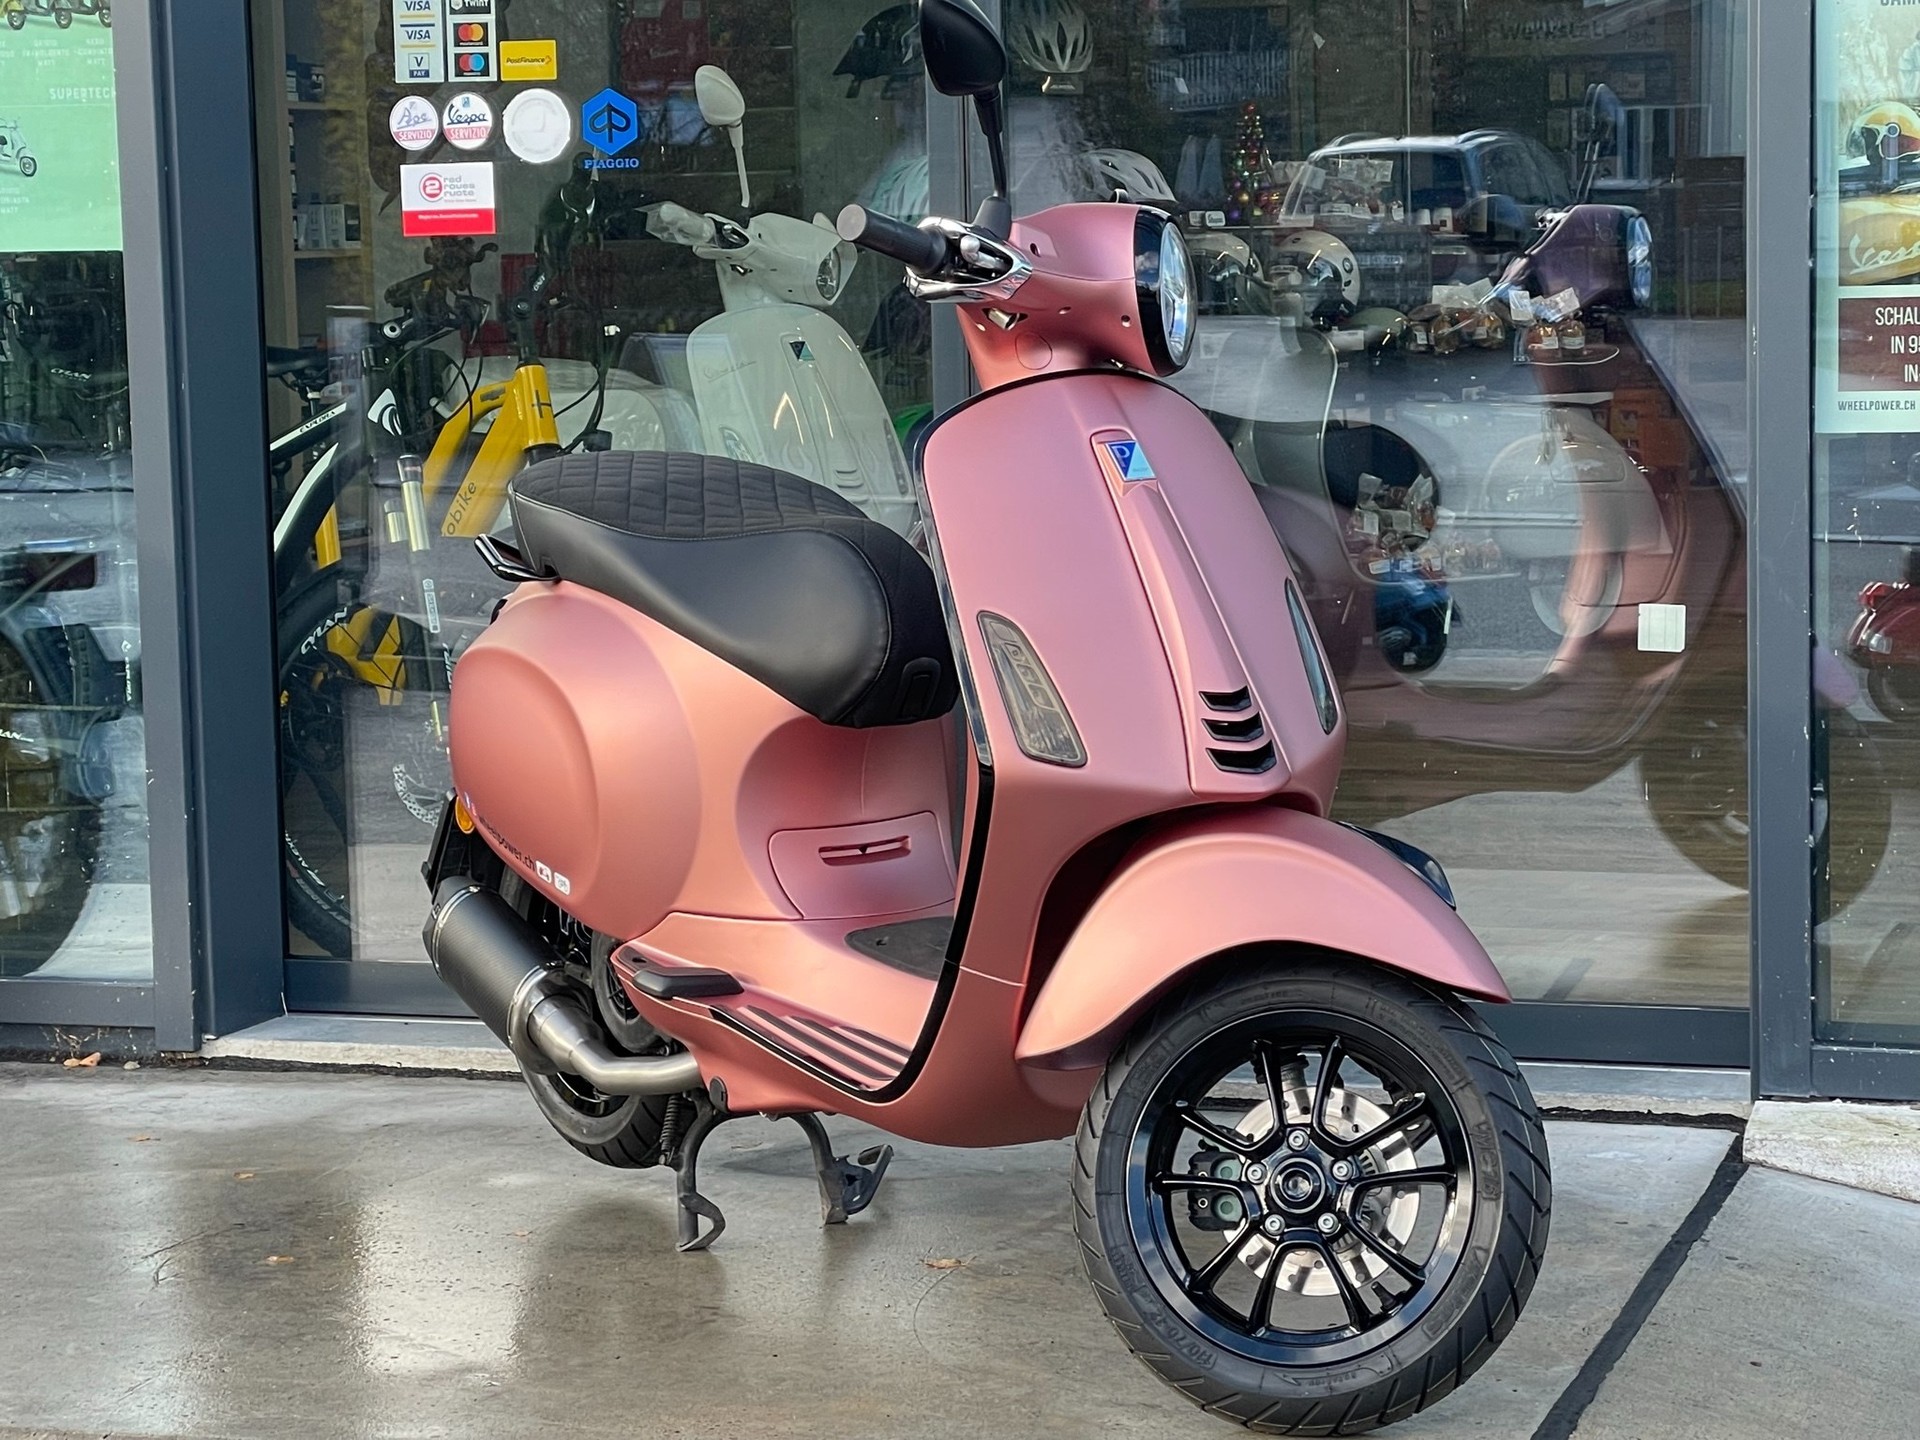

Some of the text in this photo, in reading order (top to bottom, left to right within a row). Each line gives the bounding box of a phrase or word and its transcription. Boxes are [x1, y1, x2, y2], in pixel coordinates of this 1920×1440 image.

[405, 0, 431, 11] VISA
[405, 29, 431, 40] VISA
[414, 56, 424, 67] V
[506, 56, 546, 64] PostFinance
[413, 69, 426, 77] PAY
[446, 103, 489, 126] Vespa
[399, 129, 433, 141] SERVIZIO
[450, 127, 488, 140] SERVIZIO
[584, 157, 641, 169] PIAGGIO
[1890, 335, 1920, 354] IN 9
[1837, 400, 1917, 411] WHEELPOWER.CH
